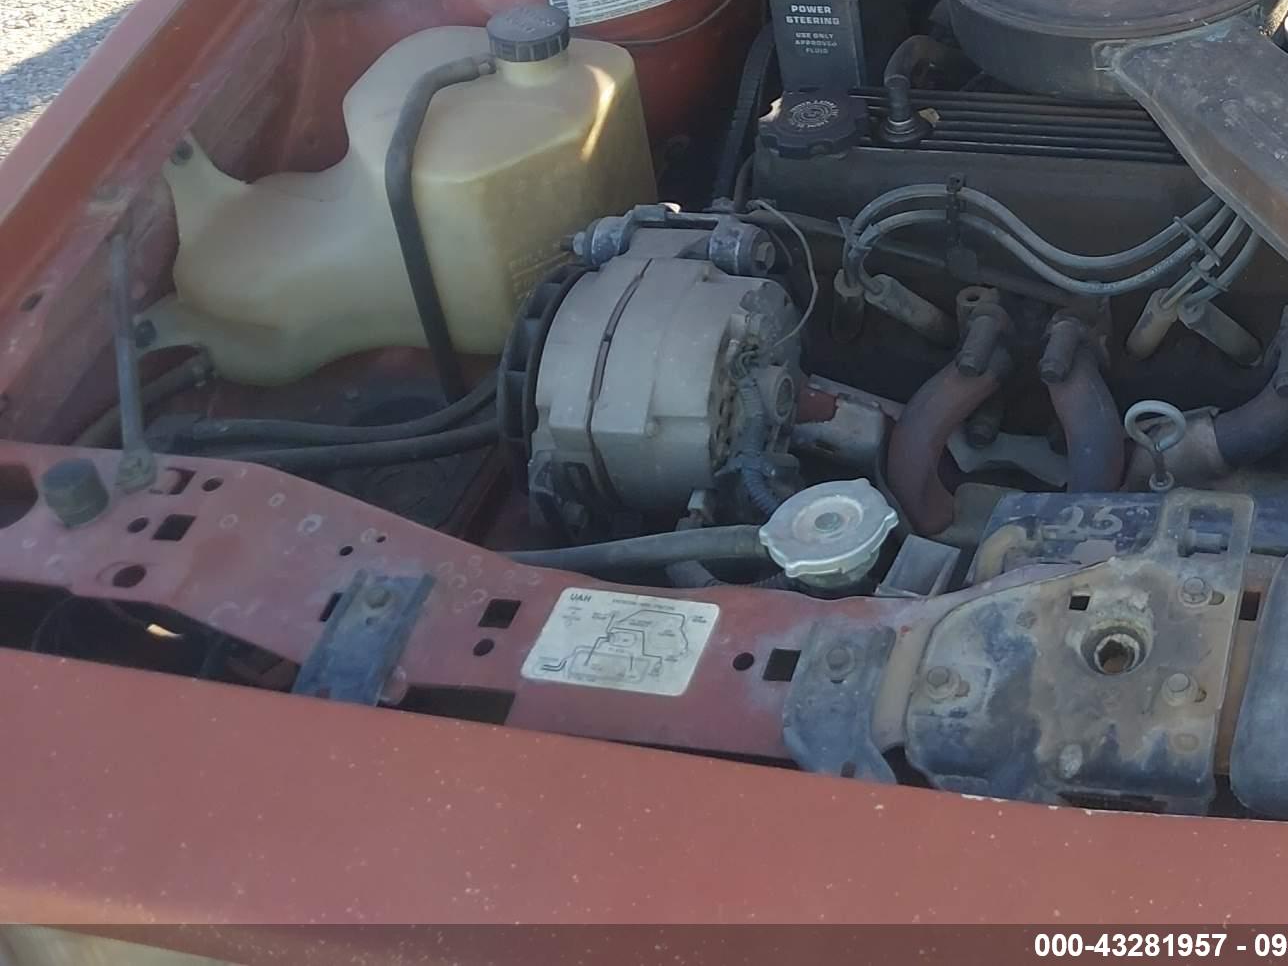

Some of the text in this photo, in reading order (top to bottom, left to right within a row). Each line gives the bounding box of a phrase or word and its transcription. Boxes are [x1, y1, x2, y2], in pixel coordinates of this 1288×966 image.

[791, 4, 832, 14] POWER
[786, 15, 840, 26] STEERING
[570, 593, 592, 603] UAH
